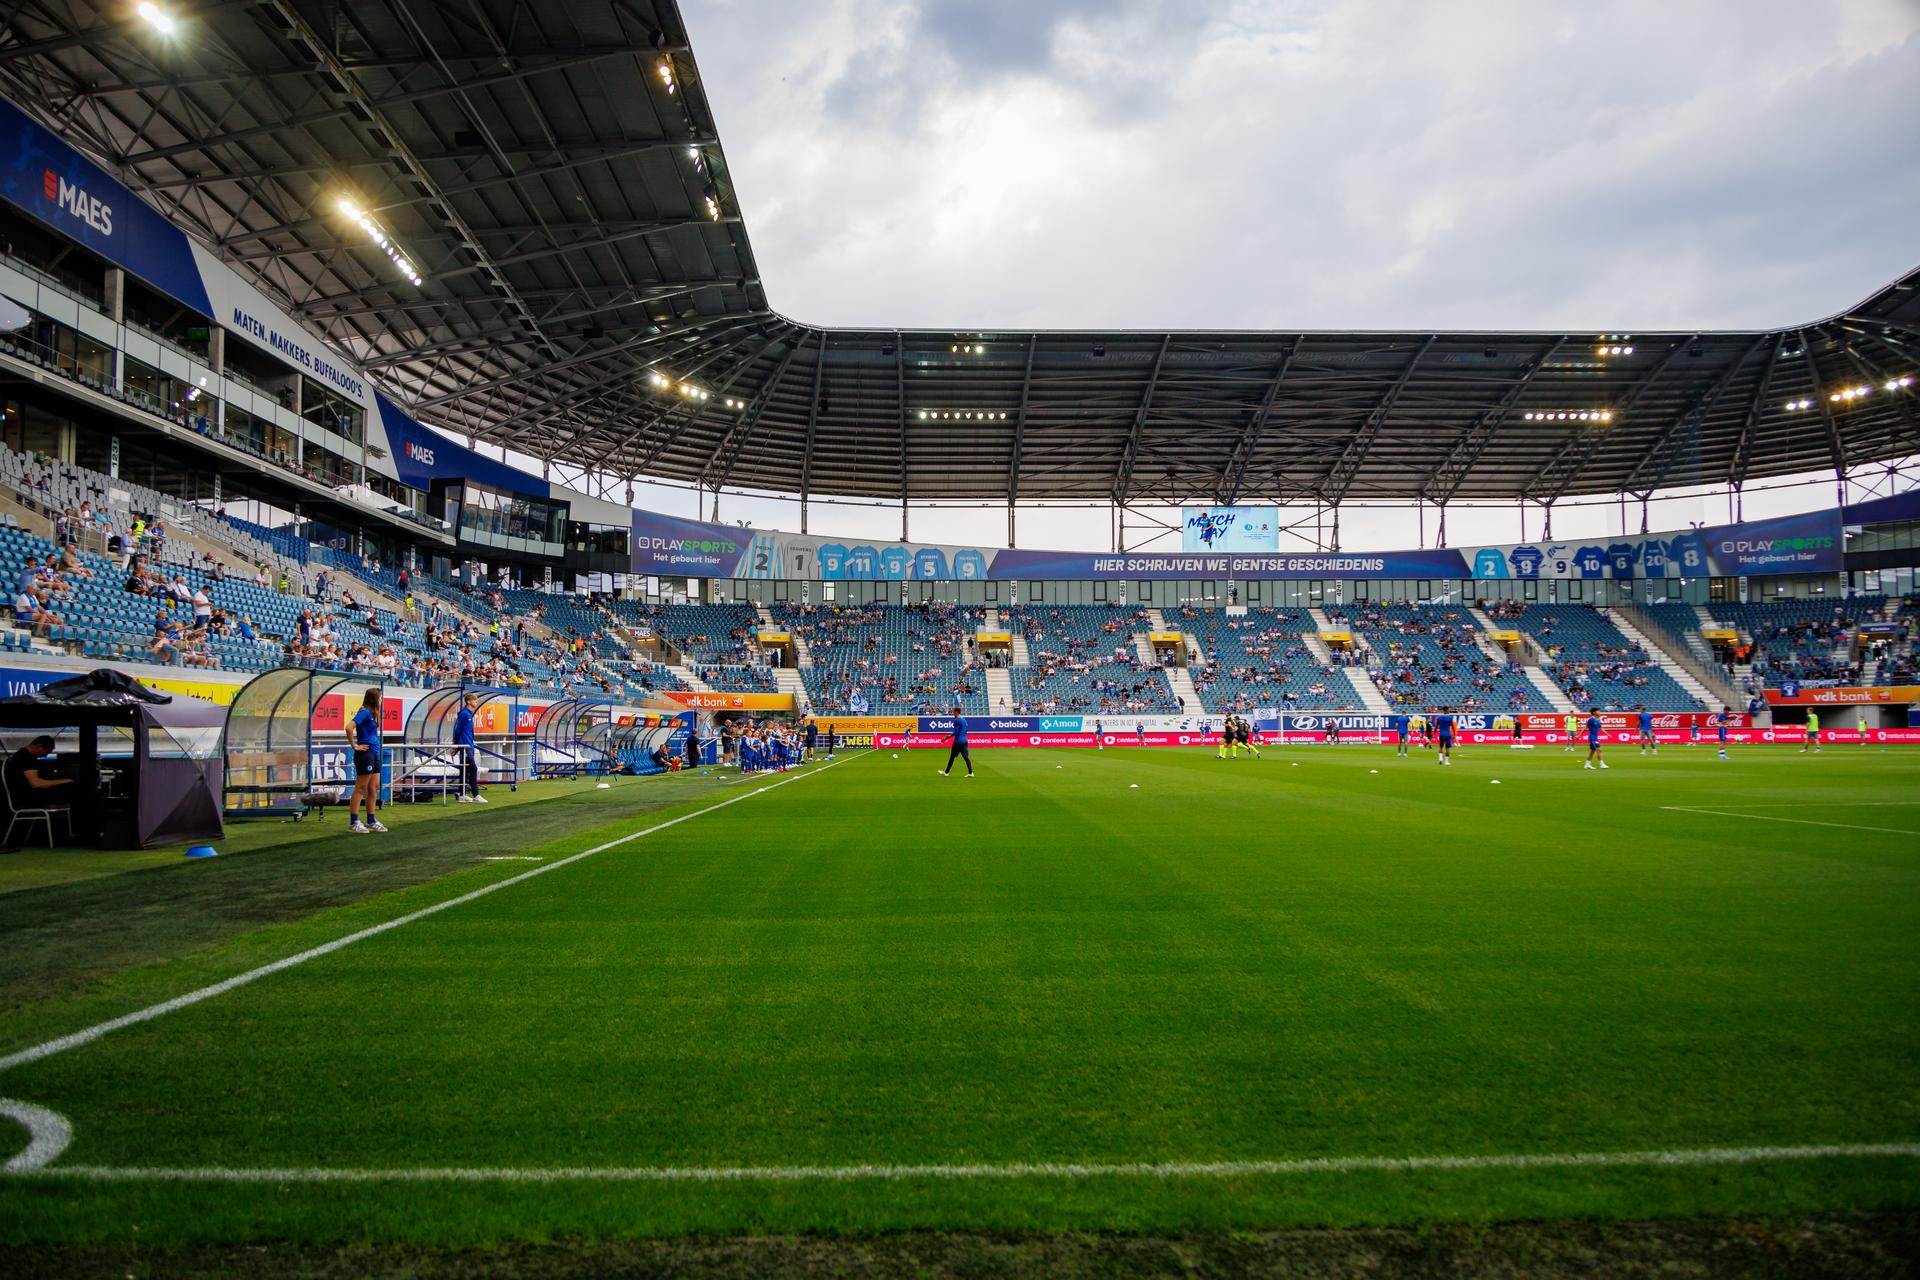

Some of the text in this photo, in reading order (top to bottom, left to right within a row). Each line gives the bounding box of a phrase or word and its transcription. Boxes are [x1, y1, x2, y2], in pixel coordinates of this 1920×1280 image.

[59, 176, 113, 236] MAES
[233, 308, 365, 399] MATEN. MAKKERS. BUFFALOOO'S.
[411, 443, 435, 466] MAES
[1188, 514, 1236, 529] MTCH
[653, 552, 721, 564] Het gebeurt hier
[755, 553, 768, 571] 2
[795, 555, 804, 570] 1
[828, 558, 838, 571] 9
[1616, 557, 1626, 569] 6
[1646, 555, 1664, 567] 20
[1684, 550, 1700, 567] 8
[1739, 552, 1816, 564] Het gebeurt hier
[855, 559, 870, 572] 11
[890, 561, 901, 574] 9
[924, 561, 935, 577] 5
[962, 563, 975, 577] 9
[1094, 558, 1384, 572] HIER SCHRIJVEN WE GENTSE GESCHIEDENIS
[1484, 560, 1496, 576] 2
[1521, 560, 1533, 574] 9
[1556, 560, 1567, 573] 9
[1583, 559, 1599, 571] 10
[686, 695, 728, 707] vdk bank
[1813, 690, 1872, 702] vdk bank
[316, 707, 339, 719] CWS
[999, 720, 1029, 728] baloise
[1053, 719, 1079, 728] Amon
[1321, 716, 1389, 728] HYUNDAI
